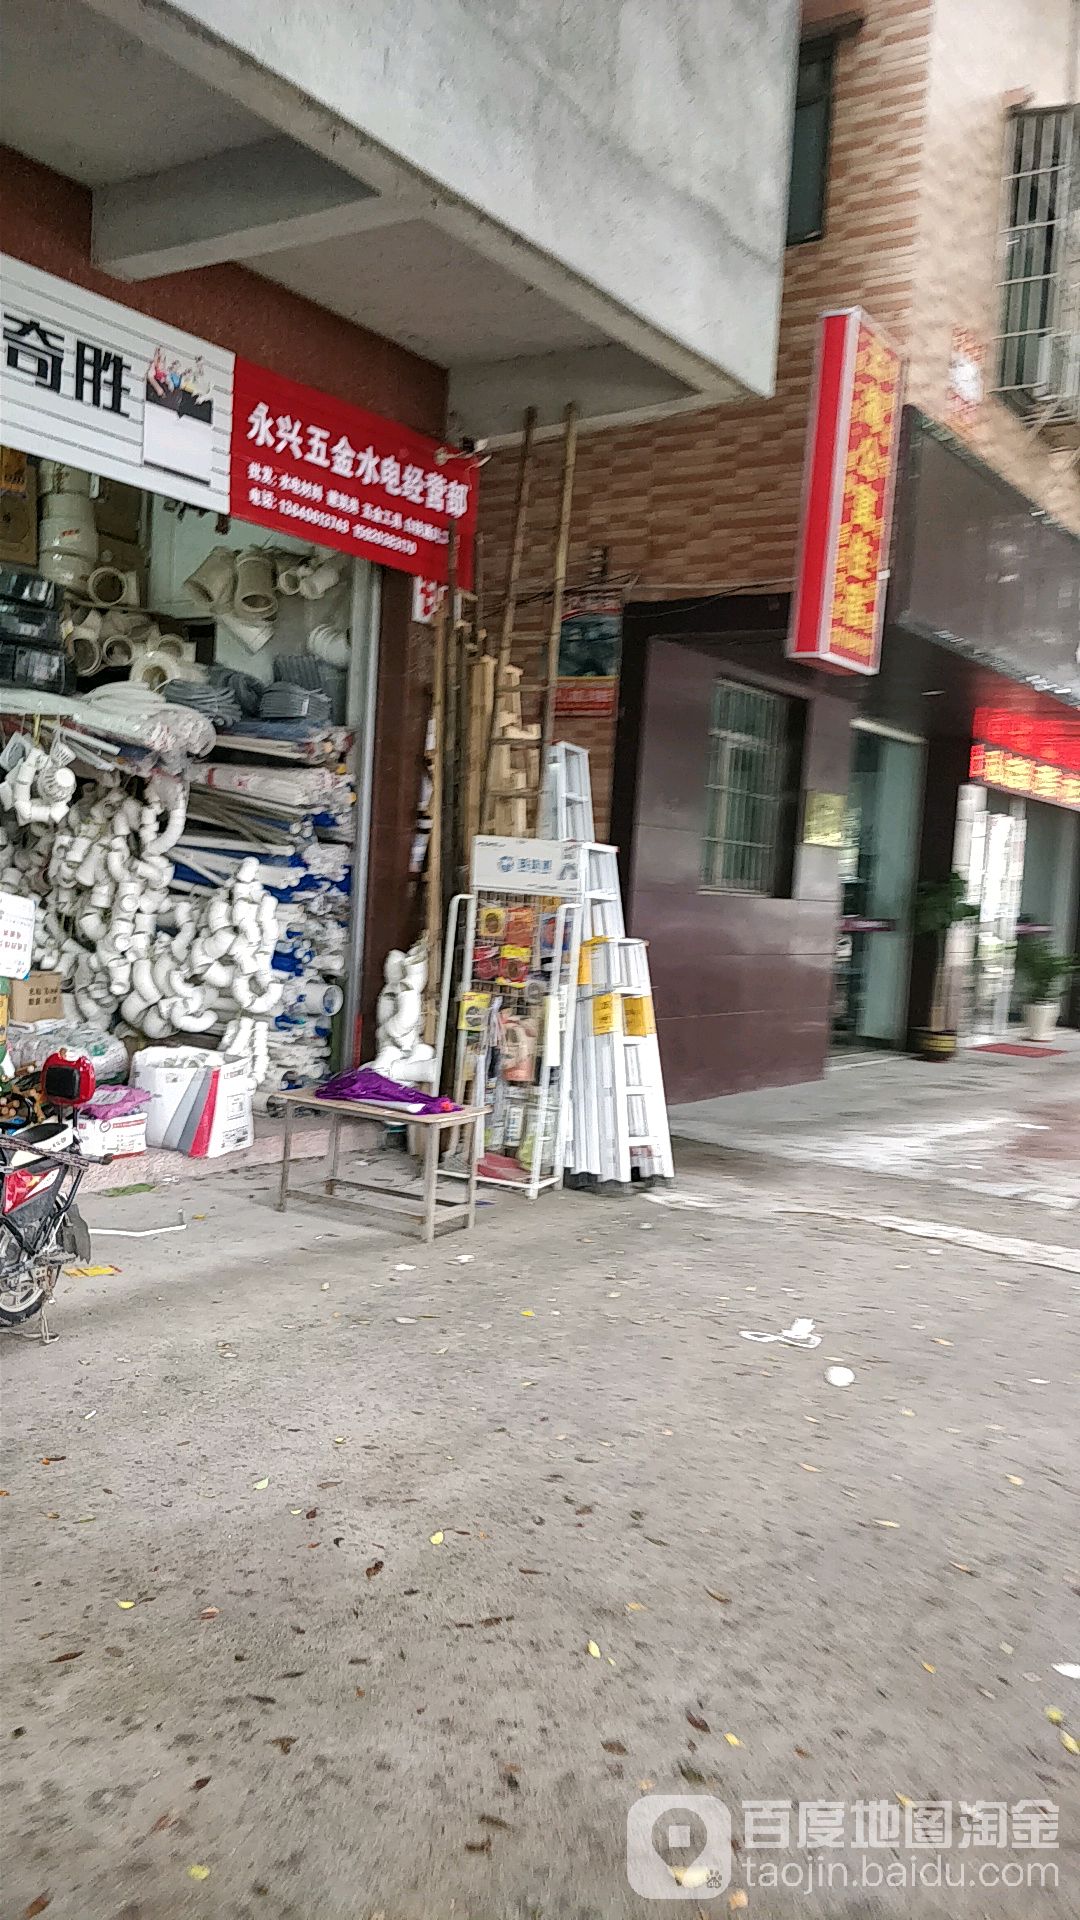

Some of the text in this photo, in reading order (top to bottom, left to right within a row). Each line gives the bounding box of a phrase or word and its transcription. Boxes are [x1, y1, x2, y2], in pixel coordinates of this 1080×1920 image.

[4, 312, 131, 418] 奇胜
[247, 401, 469, 519] 永兴五金水电经营部
